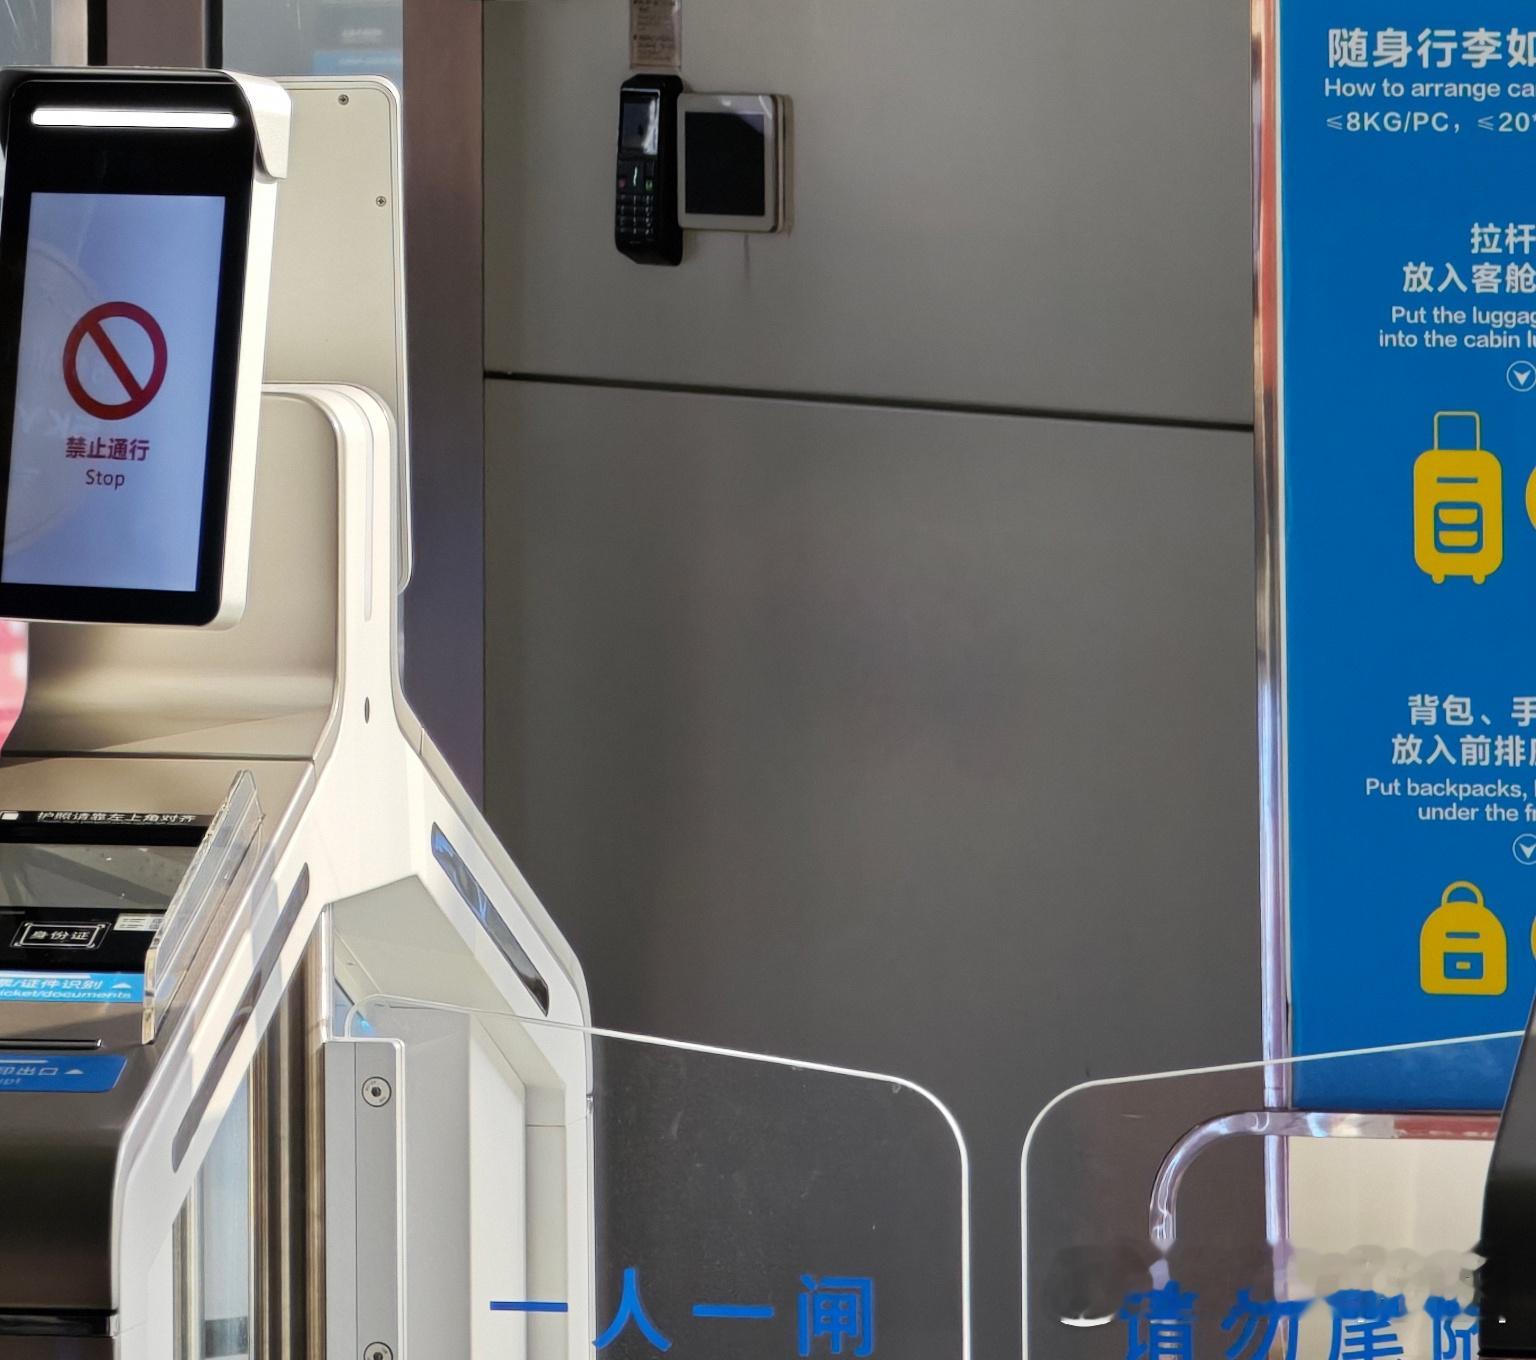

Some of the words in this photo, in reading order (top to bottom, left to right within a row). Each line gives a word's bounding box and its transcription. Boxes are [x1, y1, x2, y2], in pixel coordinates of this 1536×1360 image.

[1329, 28, 1536, 68] 随身行李如
[1325, 78, 1375, 97] How
[1382, 78, 1404, 97] to
[1412, 82, 1500, 102] arrange
[1508, 82, 1536, 97] ca
[1471, 223, 1536, 254] 拉杆
[1403, 261, 1536, 293] 放入客舱
[1392, 306, 1426, 324] Put
[1433, 306, 1466, 324] the
[1380, 330, 1417, 347] into
[1424, 330, 1457, 347] the
[1464, 330, 1520, 348] cabin
[66, 436, 149, 462] 禁止通行
[86, 469, 125, 490] Stop
[1408, 694, 1536, 726] 背包、手
[1392, 734, 1536, 767] 放入前排
[1366, 778, 1400, 796] Put
[1408, 777, 1530, 800] backpacks,
[1419, 803, 1479, 820] under
[1485, 803, 1518, 821] the
[31, 930, 90, 941] 身份证
[489, 1268, 874, 1357] 一人一闸
